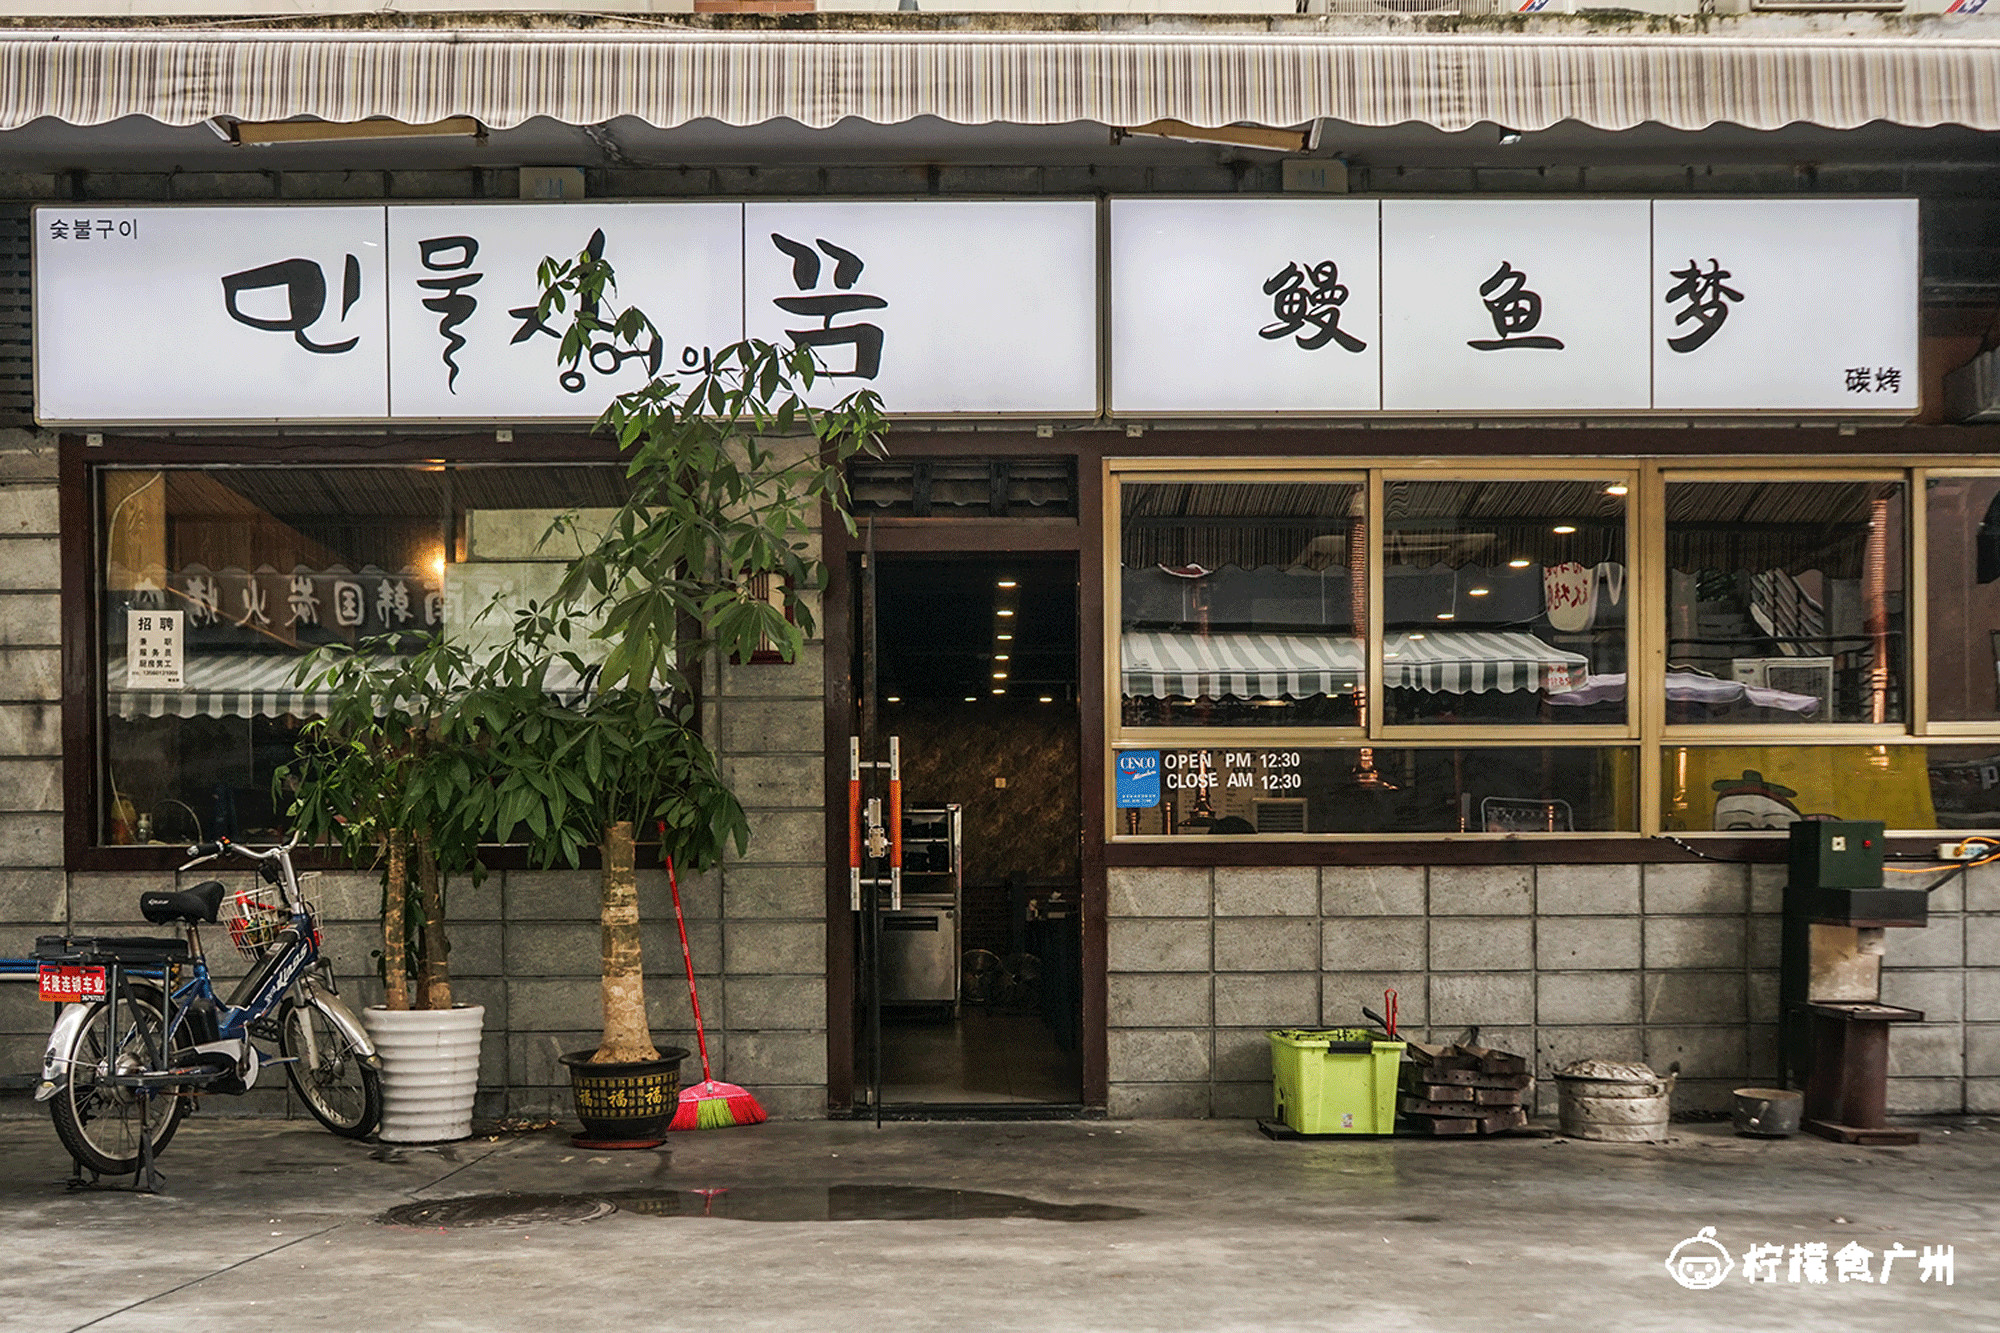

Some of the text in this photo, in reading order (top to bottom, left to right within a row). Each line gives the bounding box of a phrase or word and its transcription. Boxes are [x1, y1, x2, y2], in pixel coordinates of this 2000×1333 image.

[49, 218, 137, 240] 숯불구이
[771, 232, 889, 380] 꿈
[1259, 259, 1745, 353] 鳗鱼梦
[1845, 367, 1901, 394] 碳烤
[138, 617, 174, 632] 招聘
[1165, 752, 1301, 769] OPEN PM 12:30
[1166, 773, 1302, 790] CLOSE AM 12:30
[42, 974, 103, 993] 长隆连锁车业
[608, 1089, 628, 1108] 福
[645, 1085, 662, 1105] 福
